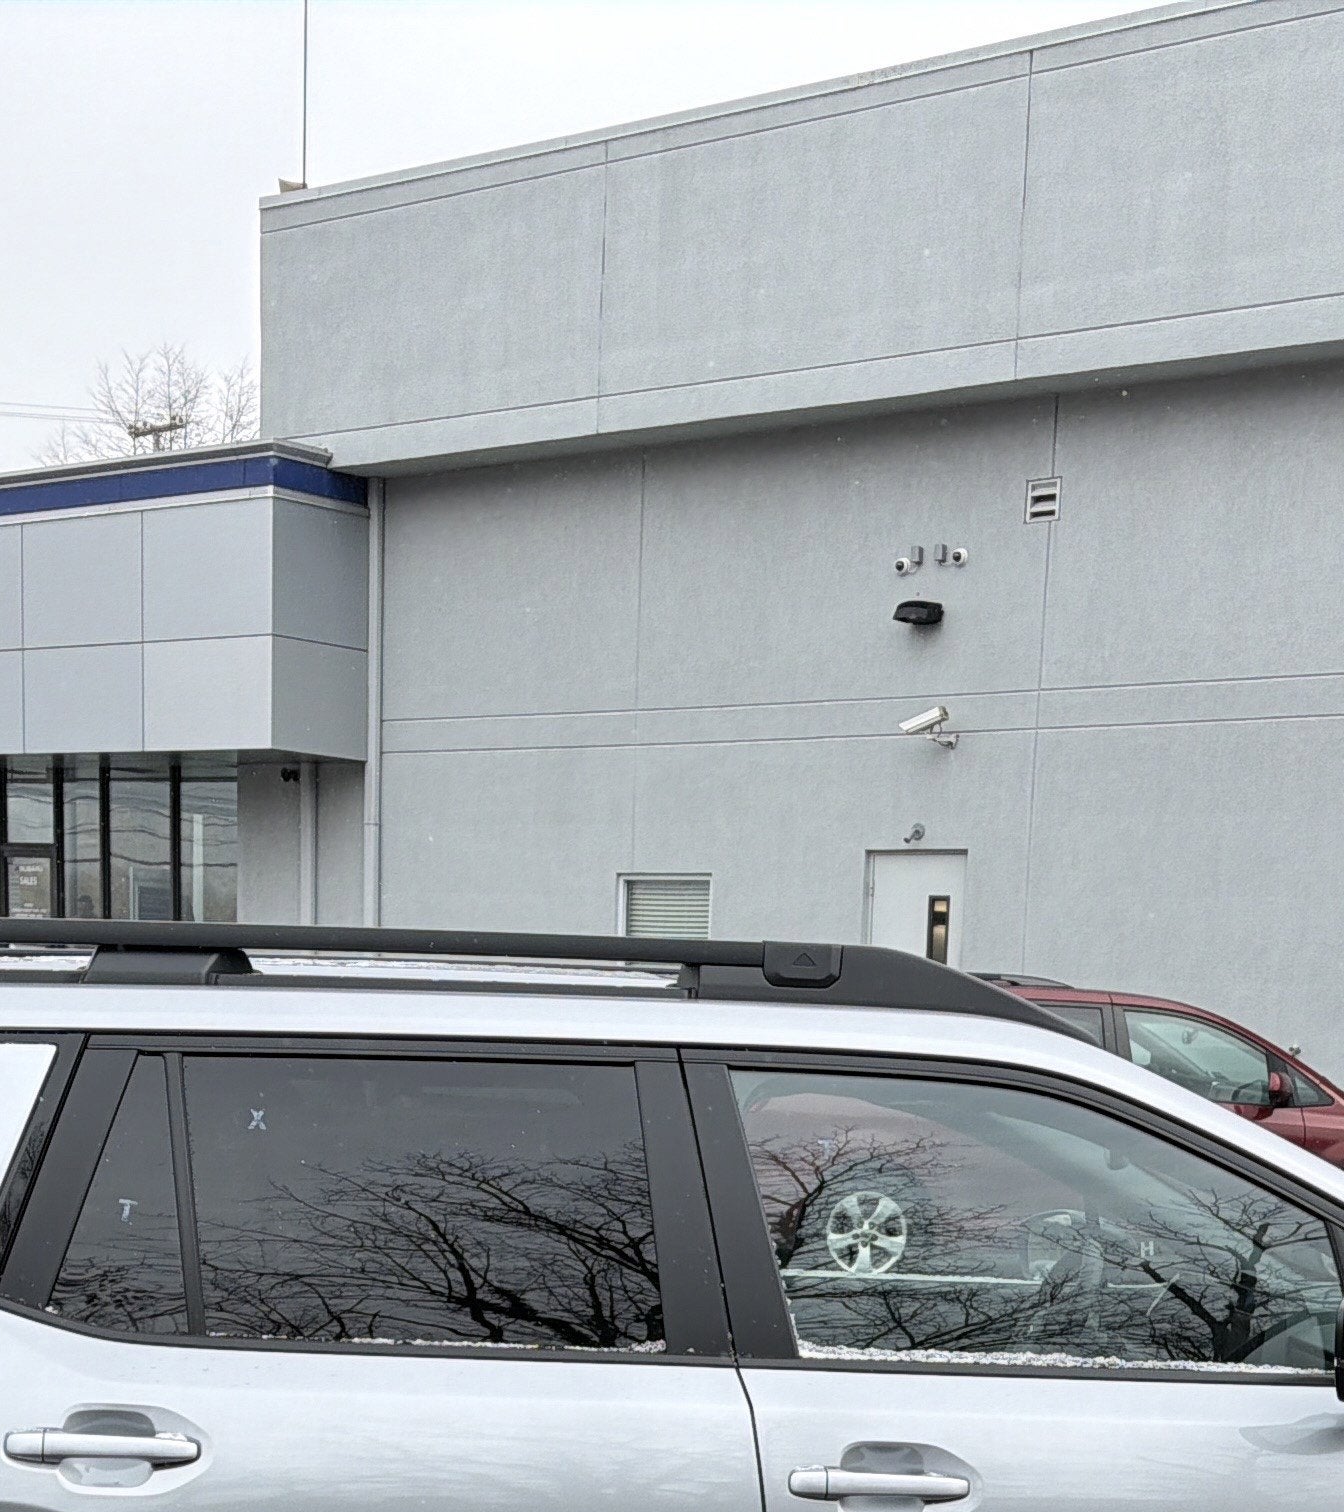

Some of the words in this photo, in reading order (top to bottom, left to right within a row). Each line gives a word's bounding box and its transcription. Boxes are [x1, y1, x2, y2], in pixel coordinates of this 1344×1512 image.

[247, 1108, 267, 1130] X
[118, 1198, 139, 1222] T
[1140, 1240, 1155, 1259] H
